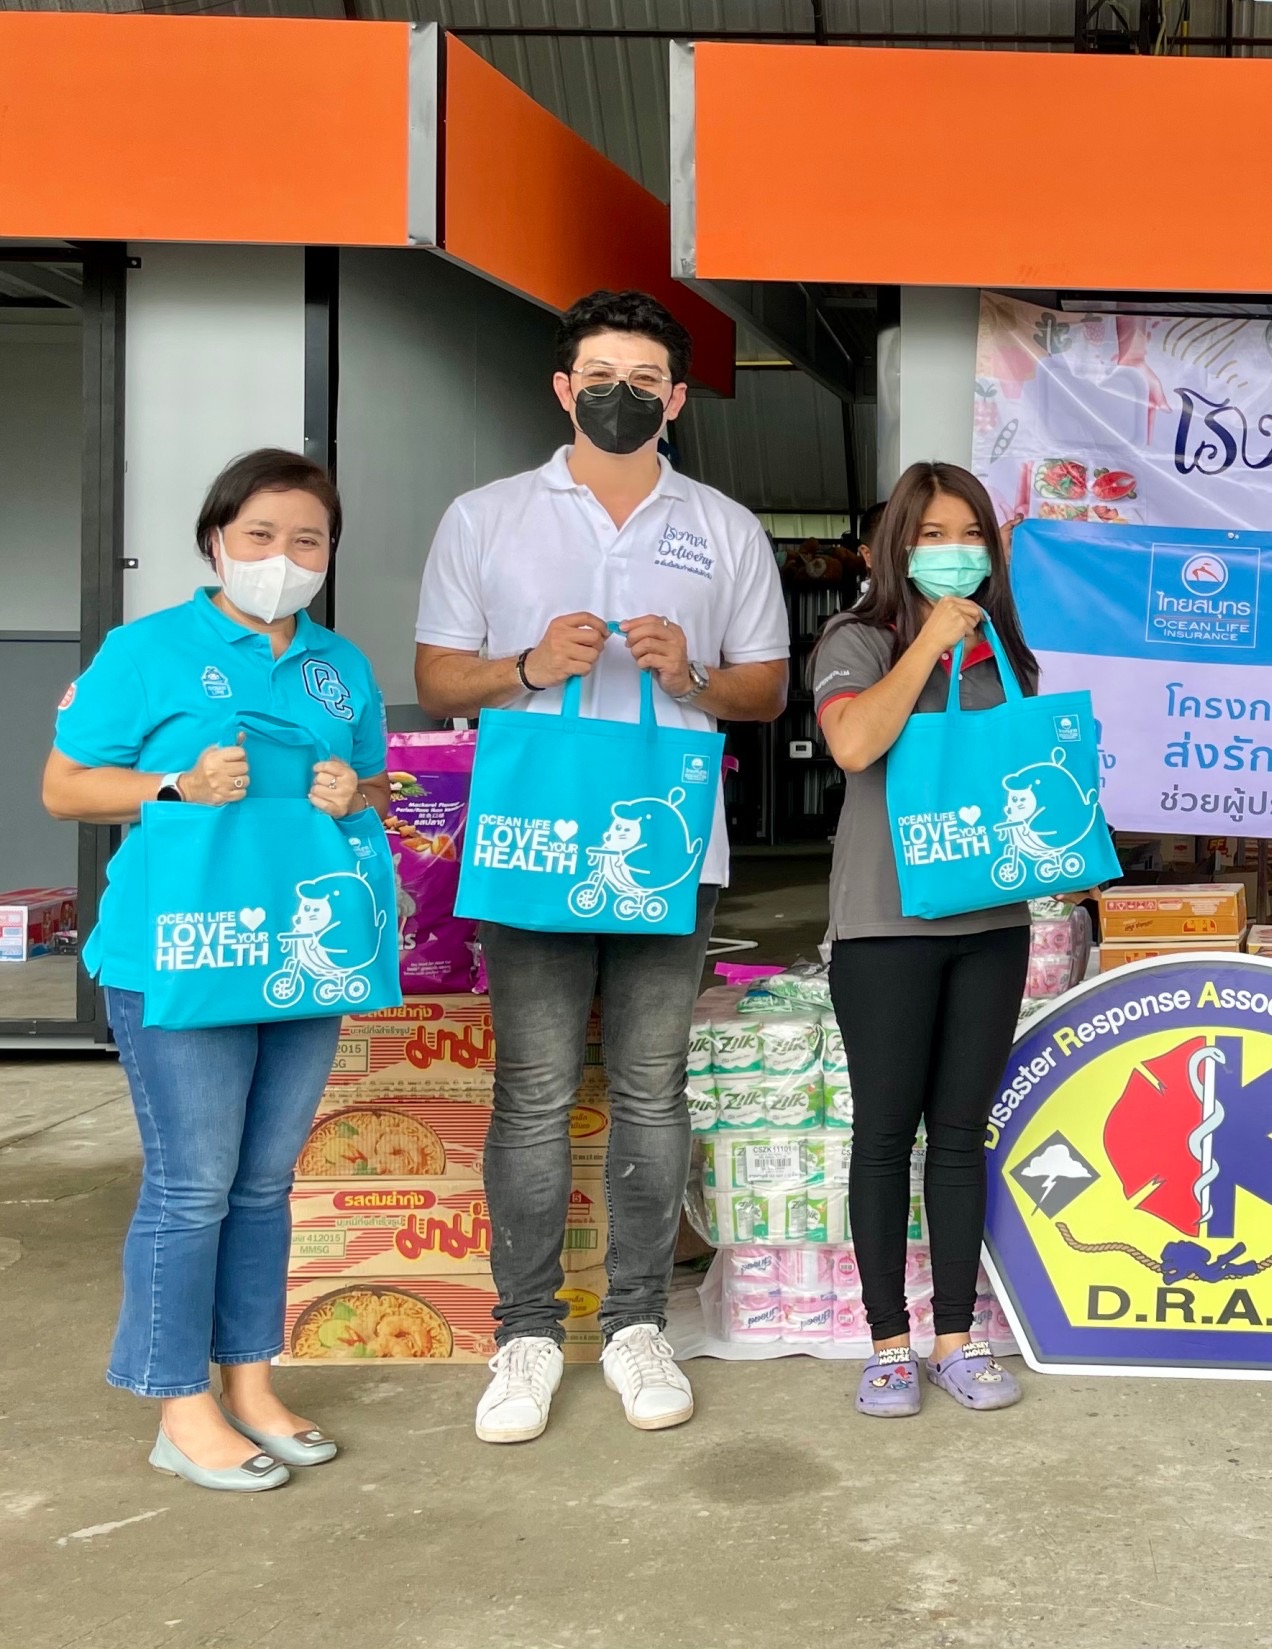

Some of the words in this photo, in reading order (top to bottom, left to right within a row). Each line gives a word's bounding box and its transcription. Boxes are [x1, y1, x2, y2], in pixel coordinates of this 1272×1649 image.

[1156, 590, 1251, 620] ไทยสมุทร
[1153, 617, 1213, 634] OCEAN
[1218, 619, 1250, 634] LIFE
[1163, 627, 1239, 641] INSURANCE
[479, 813, 521, 828] OCEAN
[524, 818, 551, 831] LIFE
[899, 814, 931, 826] OCEAN
[935, 811, 956, 822] LIFE
[476, 824, 549, 851] LOVE
[549, 841, 578, 854] YOUR
[899, 822, 959, 845] LOVE
[960, 826, 987, 837] YOUR
[473, 844, 578, 875] HEALTH
[905, 837, 991, 865] HEALTH
[157, 912, 204, 925] OCEAN
[207, 911, 236, 923] LIFE
[157, 922, 236, 948] LOVE
[236, 932, 268, 943] YOUR
[156, 942, 269, 971] HEALTH
[983, 1047, 1056, 1150] Disaster
[1053, 990, 1190, 1056] Response
[345, 1191, 425, 1209] รสต้มยำกุ้ง
[306, 1234, 341, 1242] 412015
[300, 1246, 330, 1254] MMSG
[879, 1348, 909, 1357] MICKEY
[962, 1342, 989, 1351] MICKEY
[965, 1348, 992, 1358] MOUSE
[879, 1354, 910, 1365] MOUSE
